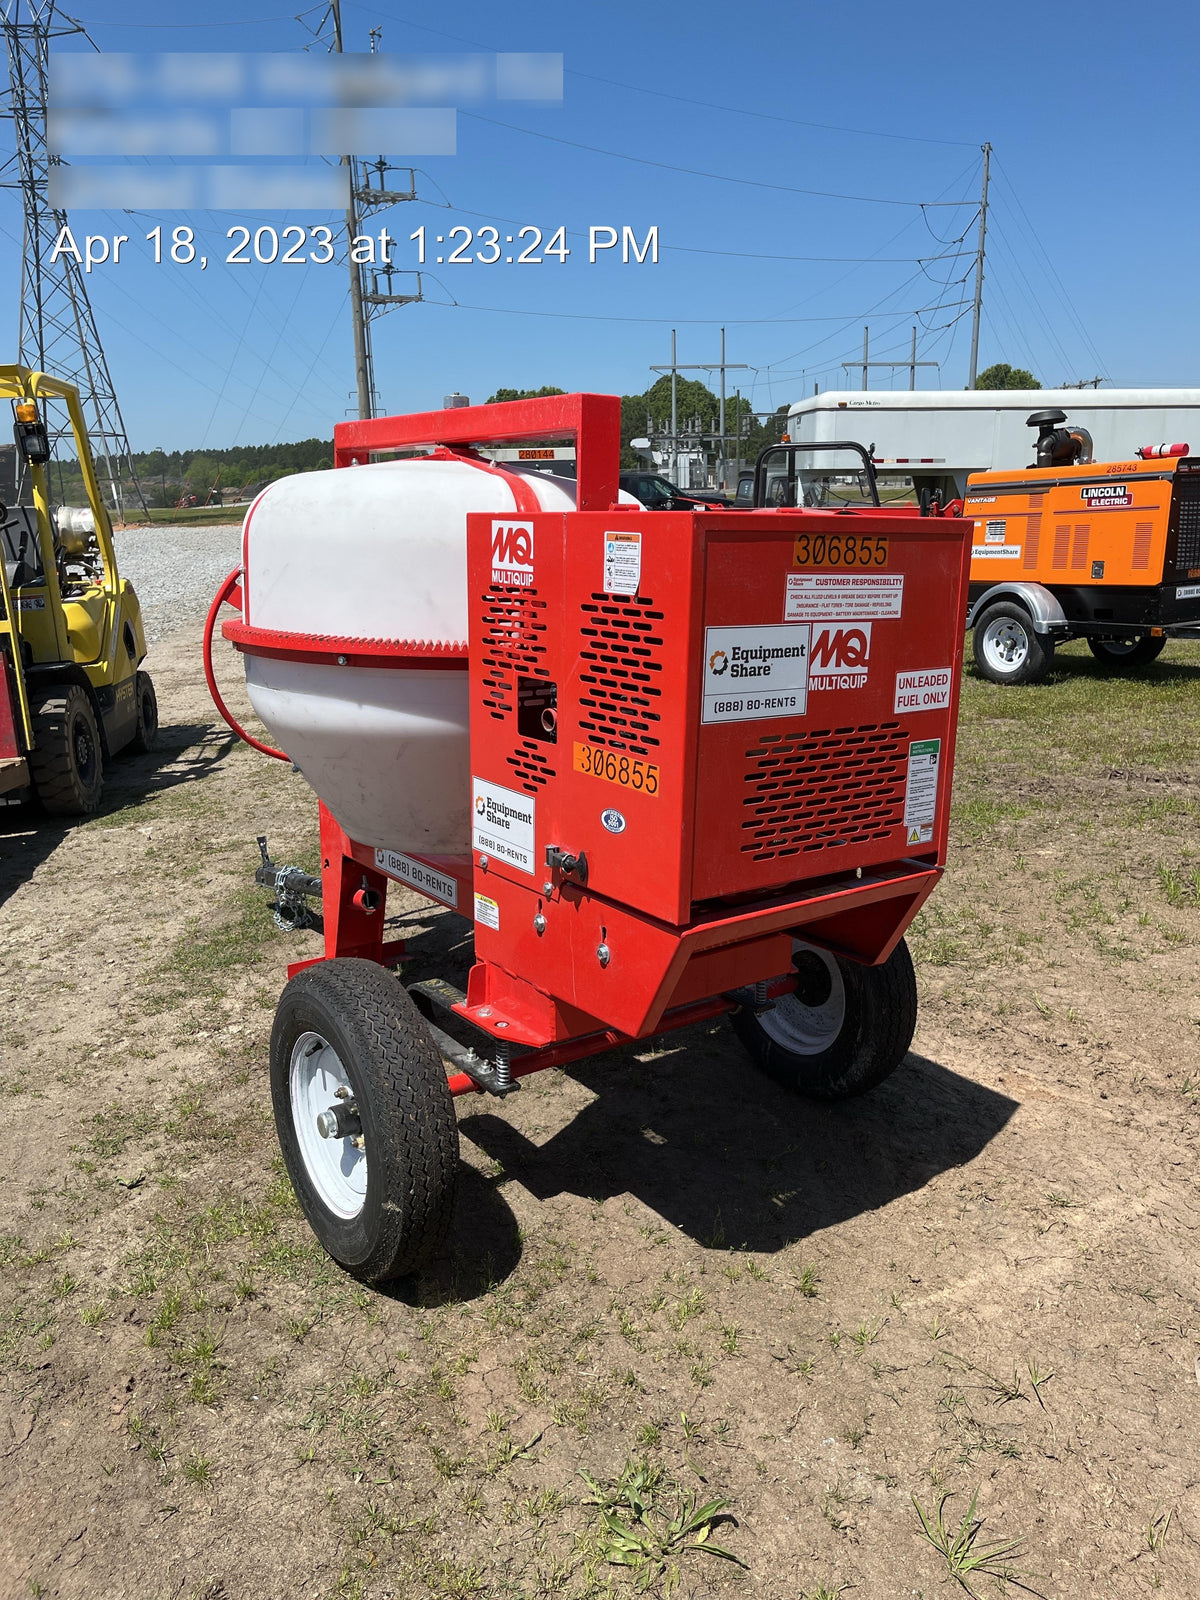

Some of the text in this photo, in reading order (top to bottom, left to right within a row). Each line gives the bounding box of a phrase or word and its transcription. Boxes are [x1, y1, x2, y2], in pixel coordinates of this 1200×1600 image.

[519, 450, 555, 459] 280144
[1106, 464, 1138, 474] 285743
[1083, 487, 1125, 498] LINCOLN
[796, 534, 888, 565] 306855
[491, 570, 534, 587] MULTIQUIP
[815, 578, 903, 586] CUSTOMER RESPONSIBILITY
[731, 644, 806, 663] Equipment
[730, 664, 771, 678] Share
[809, 675, 868, 691] MULTIQUIP
[898, 674, 948, 690] UNLEADED
[714, 696, 797, 714] (888) 80-RENTS
[897, 691, 947, 708] FUEL ONLY
[581, 745, 658, 794] 306855
[486, 796, 532, 825] Equipment
[486, 813, 510, 829] Share
[478, 834, 528, 864] (888) 80-RENTS
[388, 855, 453, 897] (888) 80-RENTS
